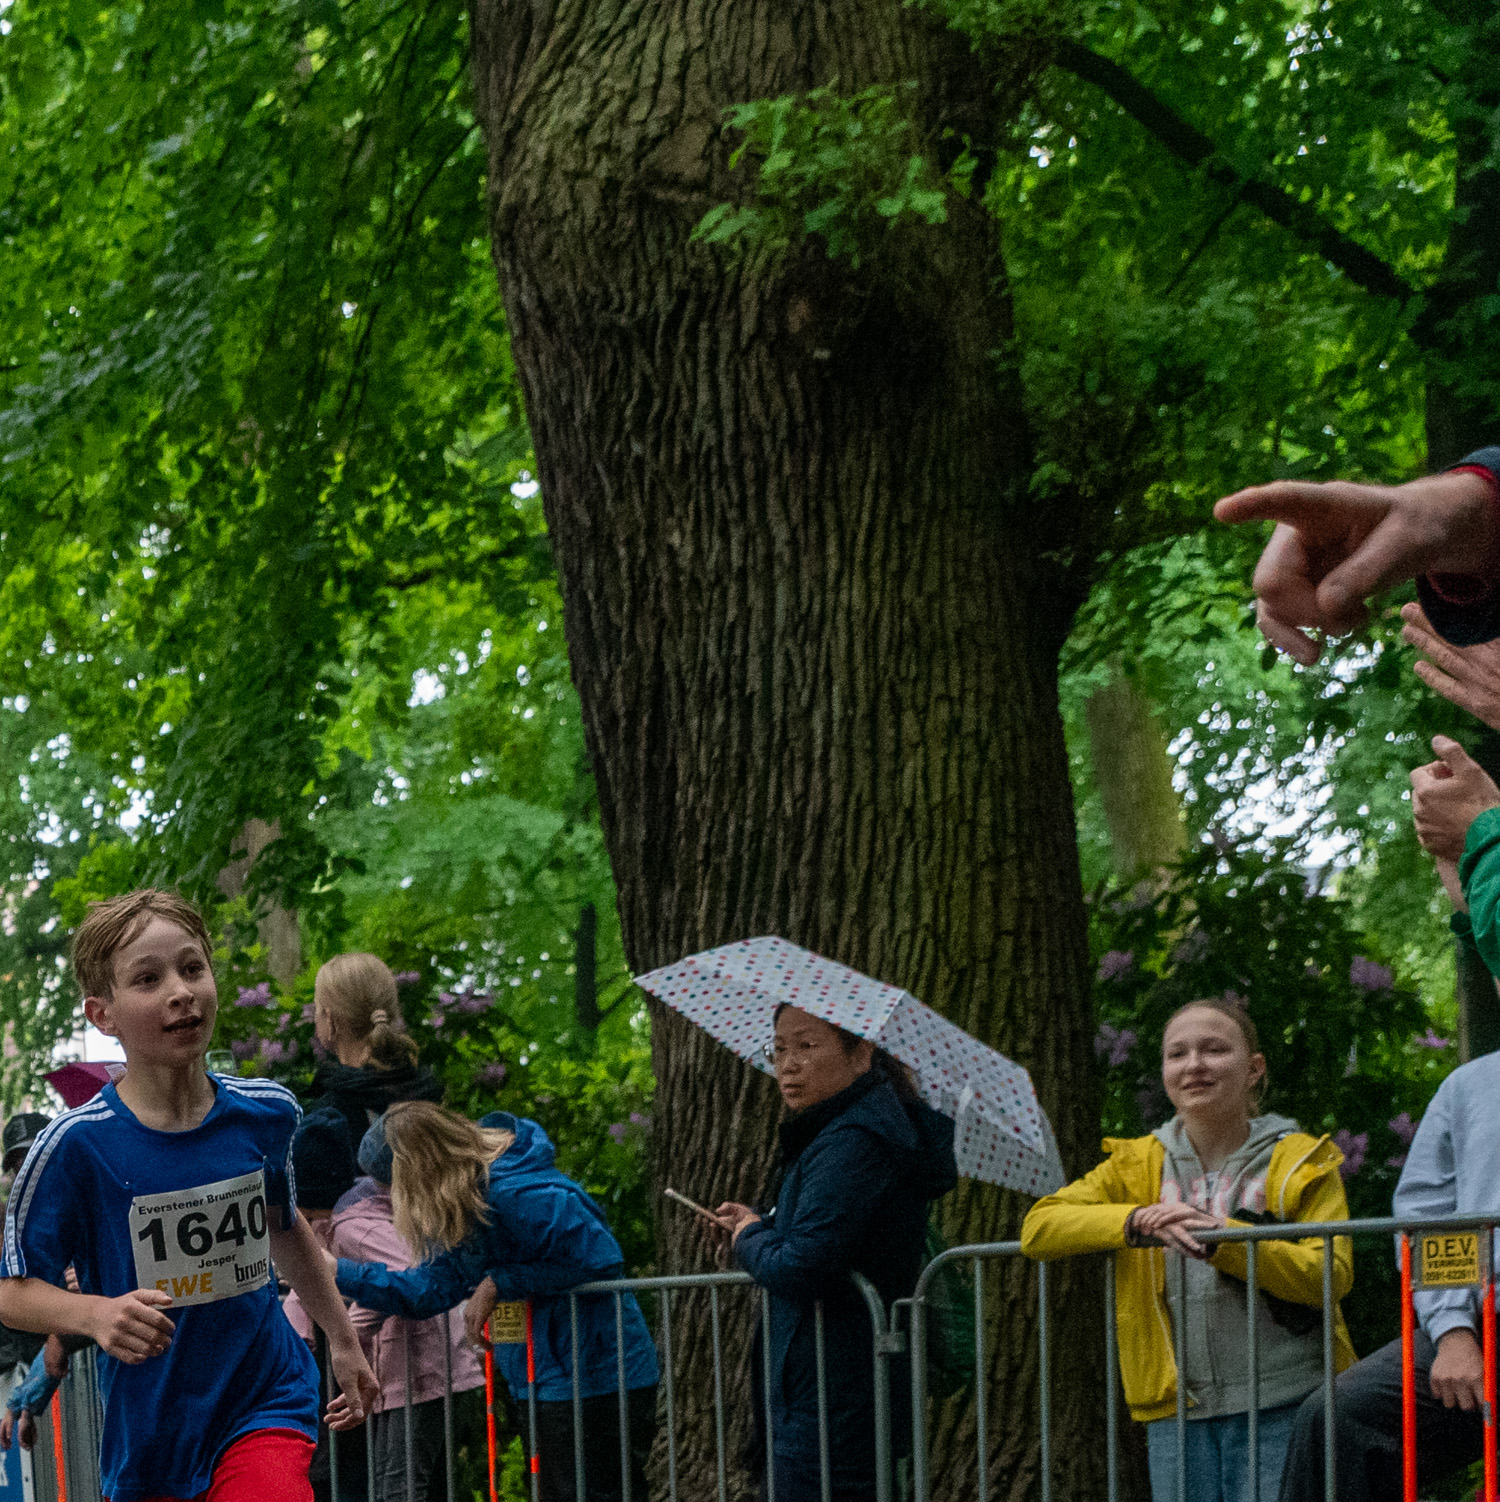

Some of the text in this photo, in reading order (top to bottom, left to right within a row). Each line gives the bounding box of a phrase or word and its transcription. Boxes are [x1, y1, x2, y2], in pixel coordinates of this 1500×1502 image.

[138, 1179, 263, 1215] Everstener Brunnenlauf
[138, 1194, 267, 1262] 1640
[197, 1253, 238, 1270] Jesper
[1426, 1236, 1475, 1259] D.E.V.
[155, 1271, 213, 1298] EWE
[234, 1258, 268, 1283] bruns
